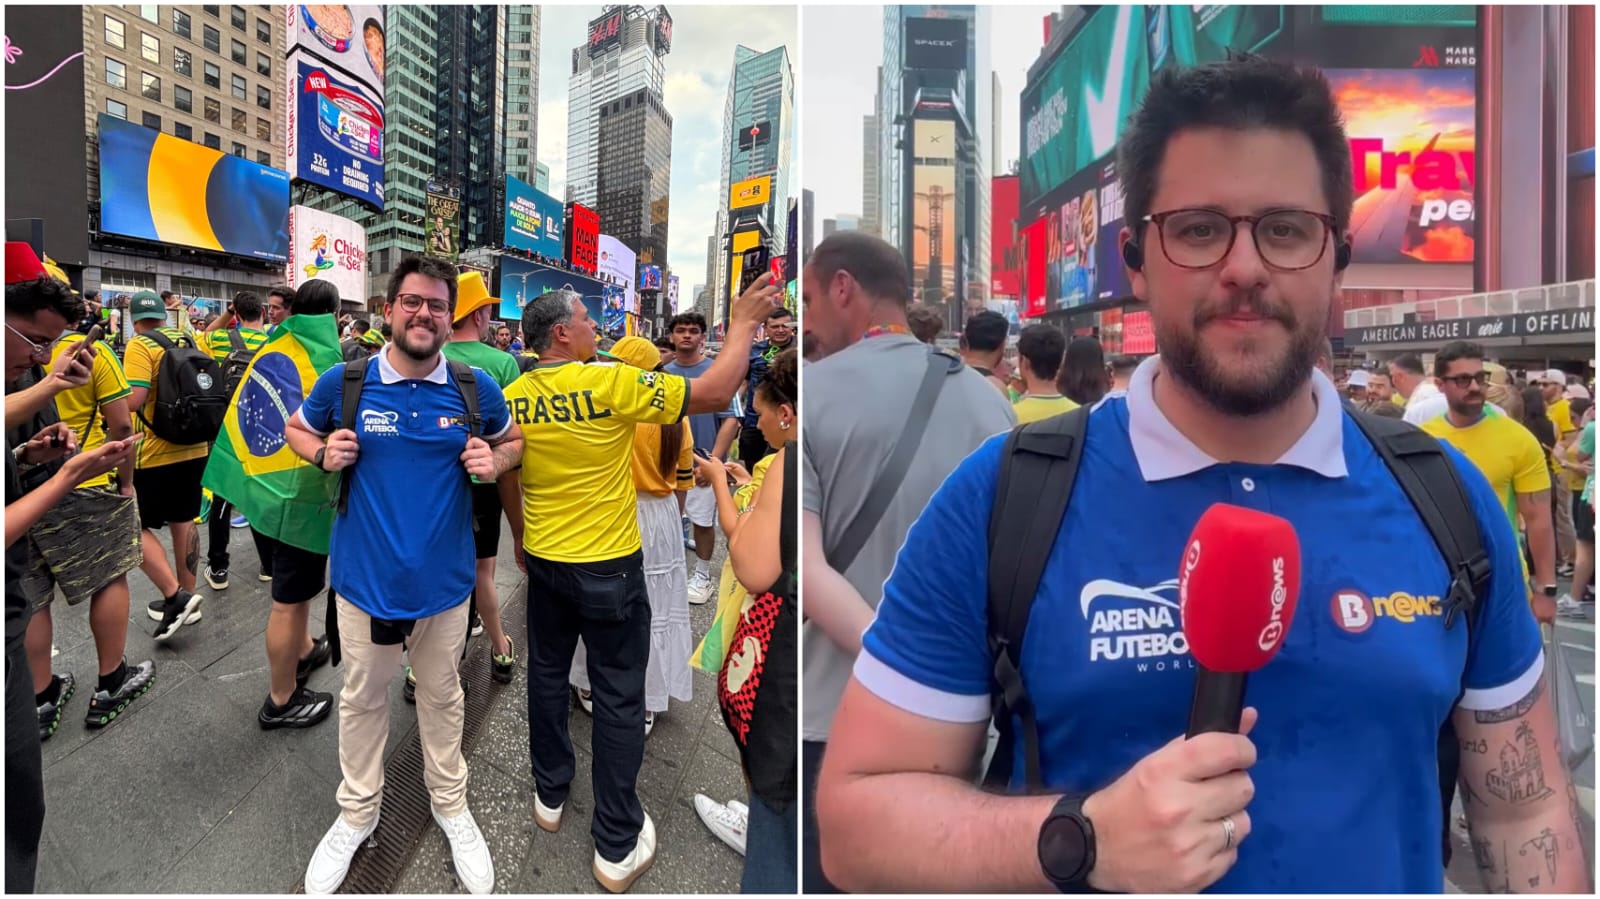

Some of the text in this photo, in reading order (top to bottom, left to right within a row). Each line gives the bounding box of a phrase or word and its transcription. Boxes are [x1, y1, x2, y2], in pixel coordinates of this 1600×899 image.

[589, 12, 620, 48] H&M
[914, 39, 958, 47] SPACEX
[309, 76, 327, 89] NEW
[313, 152, 328, 168] 32G
[352, 159, 361, 169] NO
[310, 163, 330, 177] PROTEIN
[342, 165, 369, 183] DRAINING
[342, 175, 369, 193] REQUIRED
[1419, 199, 1475, 227] pe
[576, 227, 598, 248] MAN
[346, 256, 361, 272] Sea
[575, 245, 598, 266] FACE
[1361, 326, 1416, 342] AMERICAN
[1422, 322, 1459, 339] EAGLE
[1090, 607, 1175, 634] ARENA
